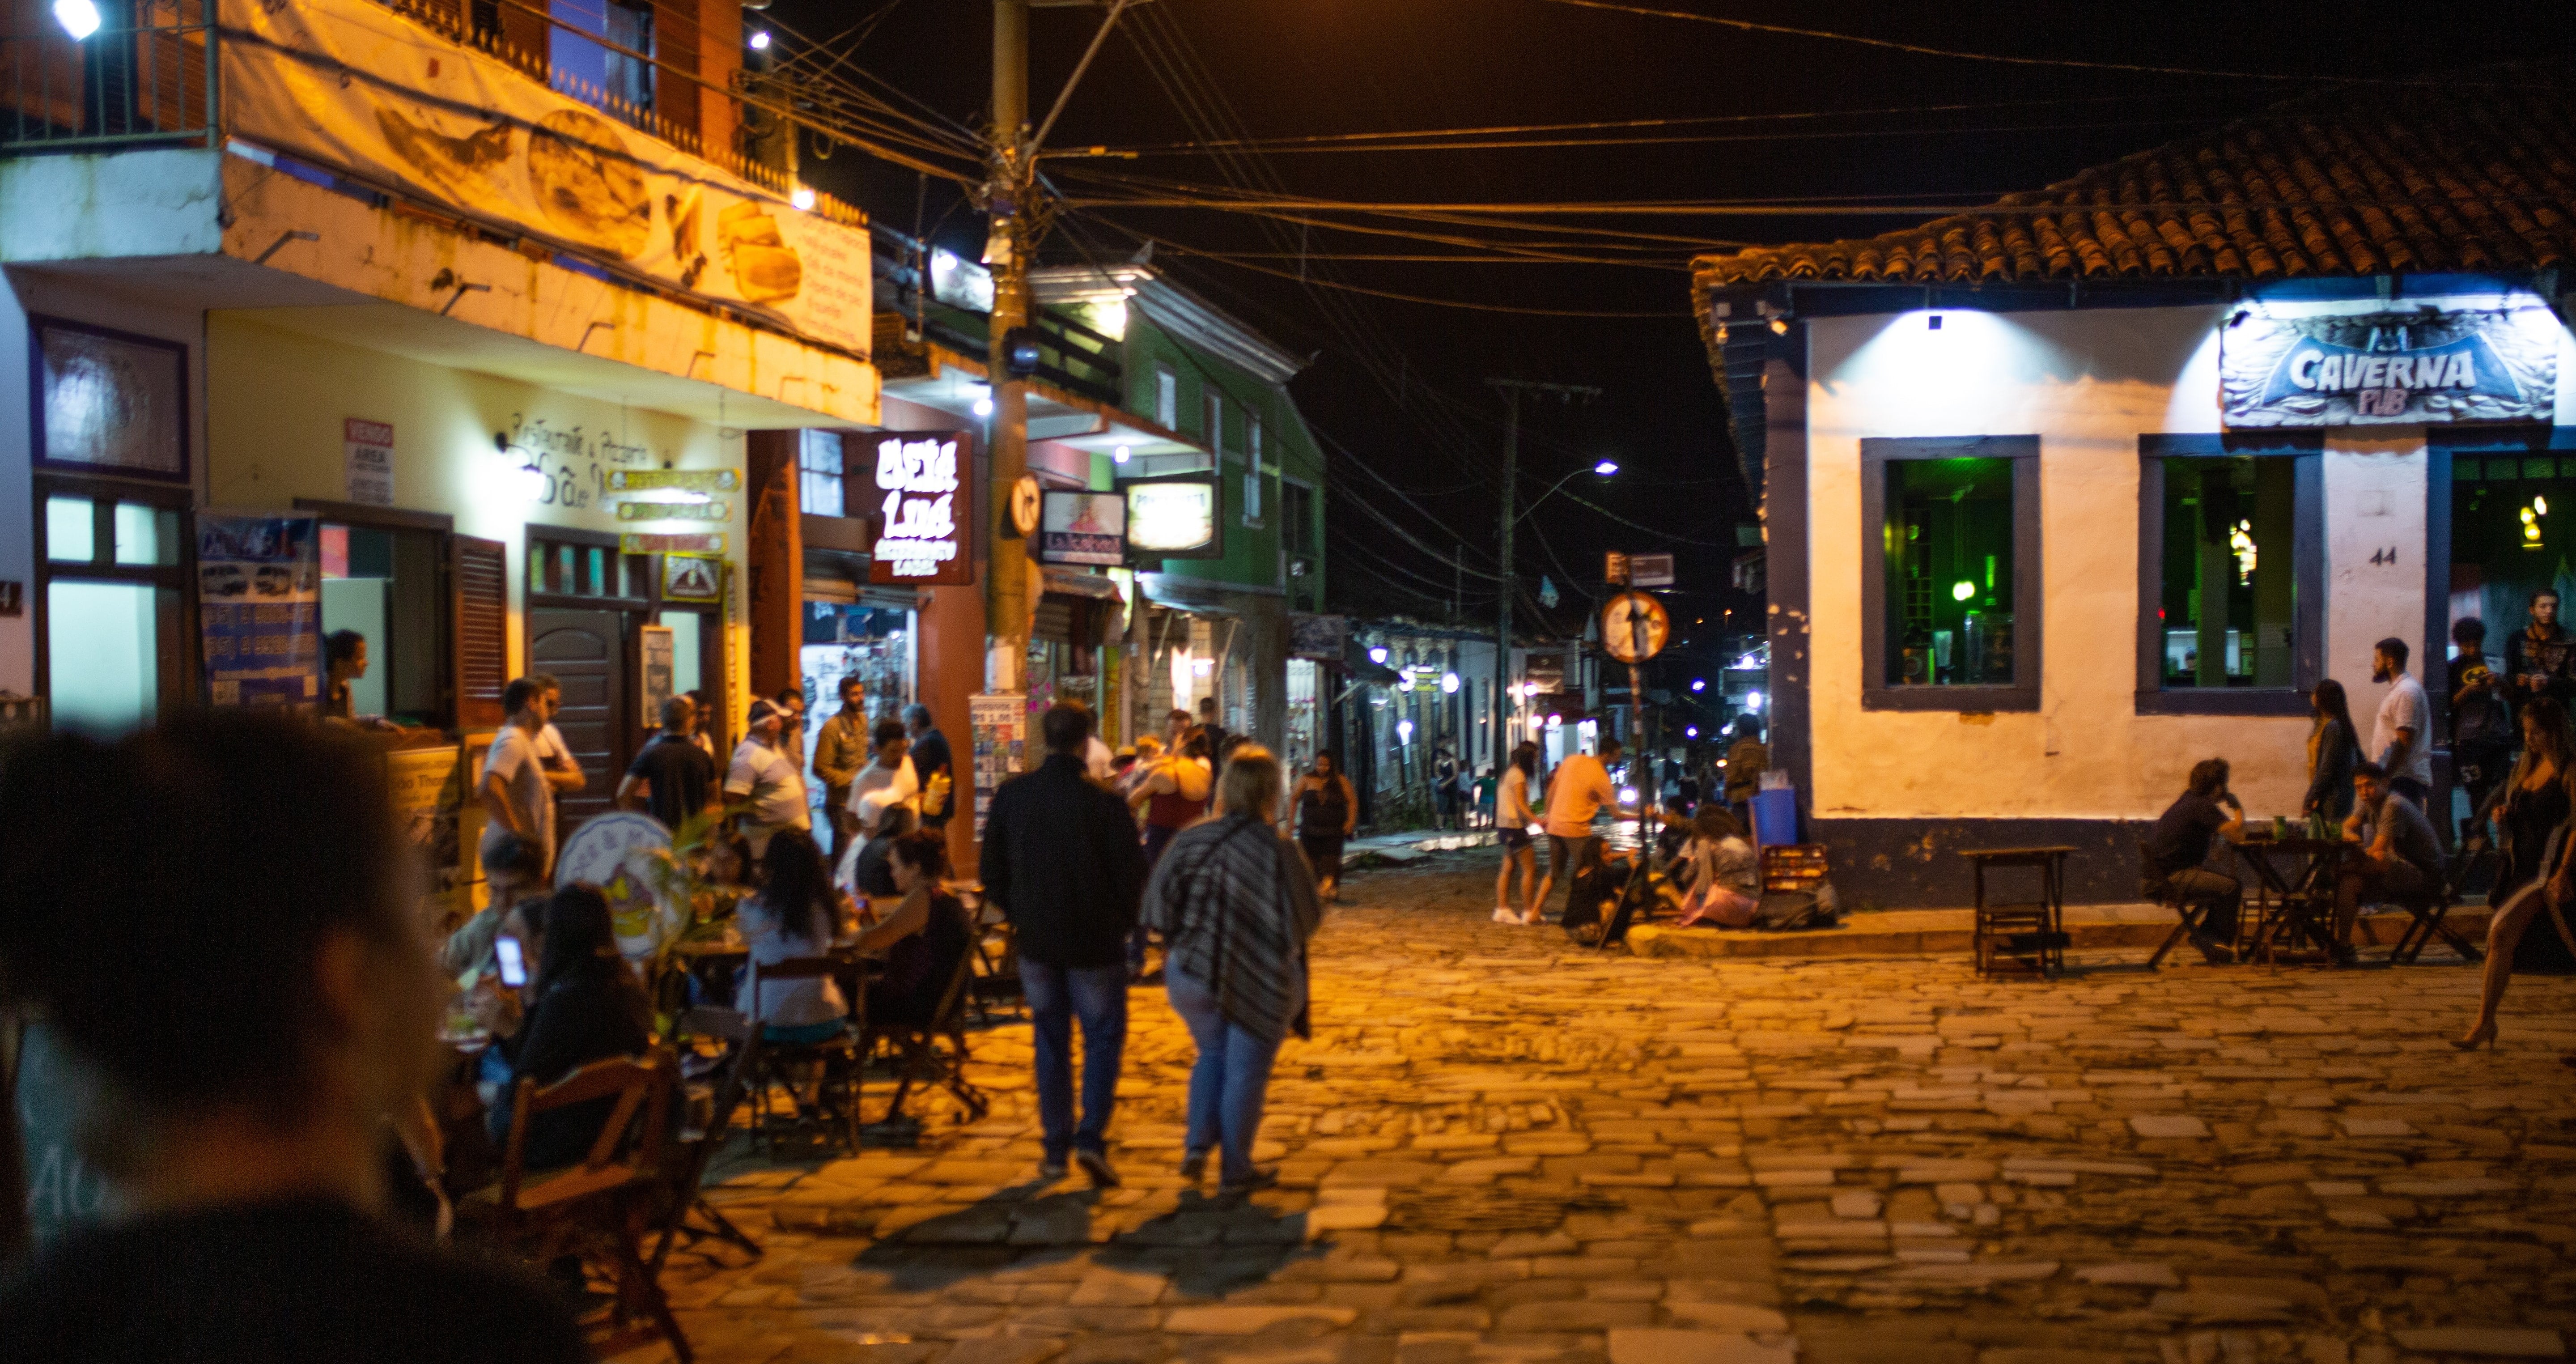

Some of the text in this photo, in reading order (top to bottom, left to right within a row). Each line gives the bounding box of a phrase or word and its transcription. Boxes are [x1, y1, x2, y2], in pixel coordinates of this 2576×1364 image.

[2290, 349, 2477, 391] CAVERNA
[2358, 389, 2408, 416] PUB
[882, 489, 955, 539] LUA
[2369, 546, 2397, 565] 44
